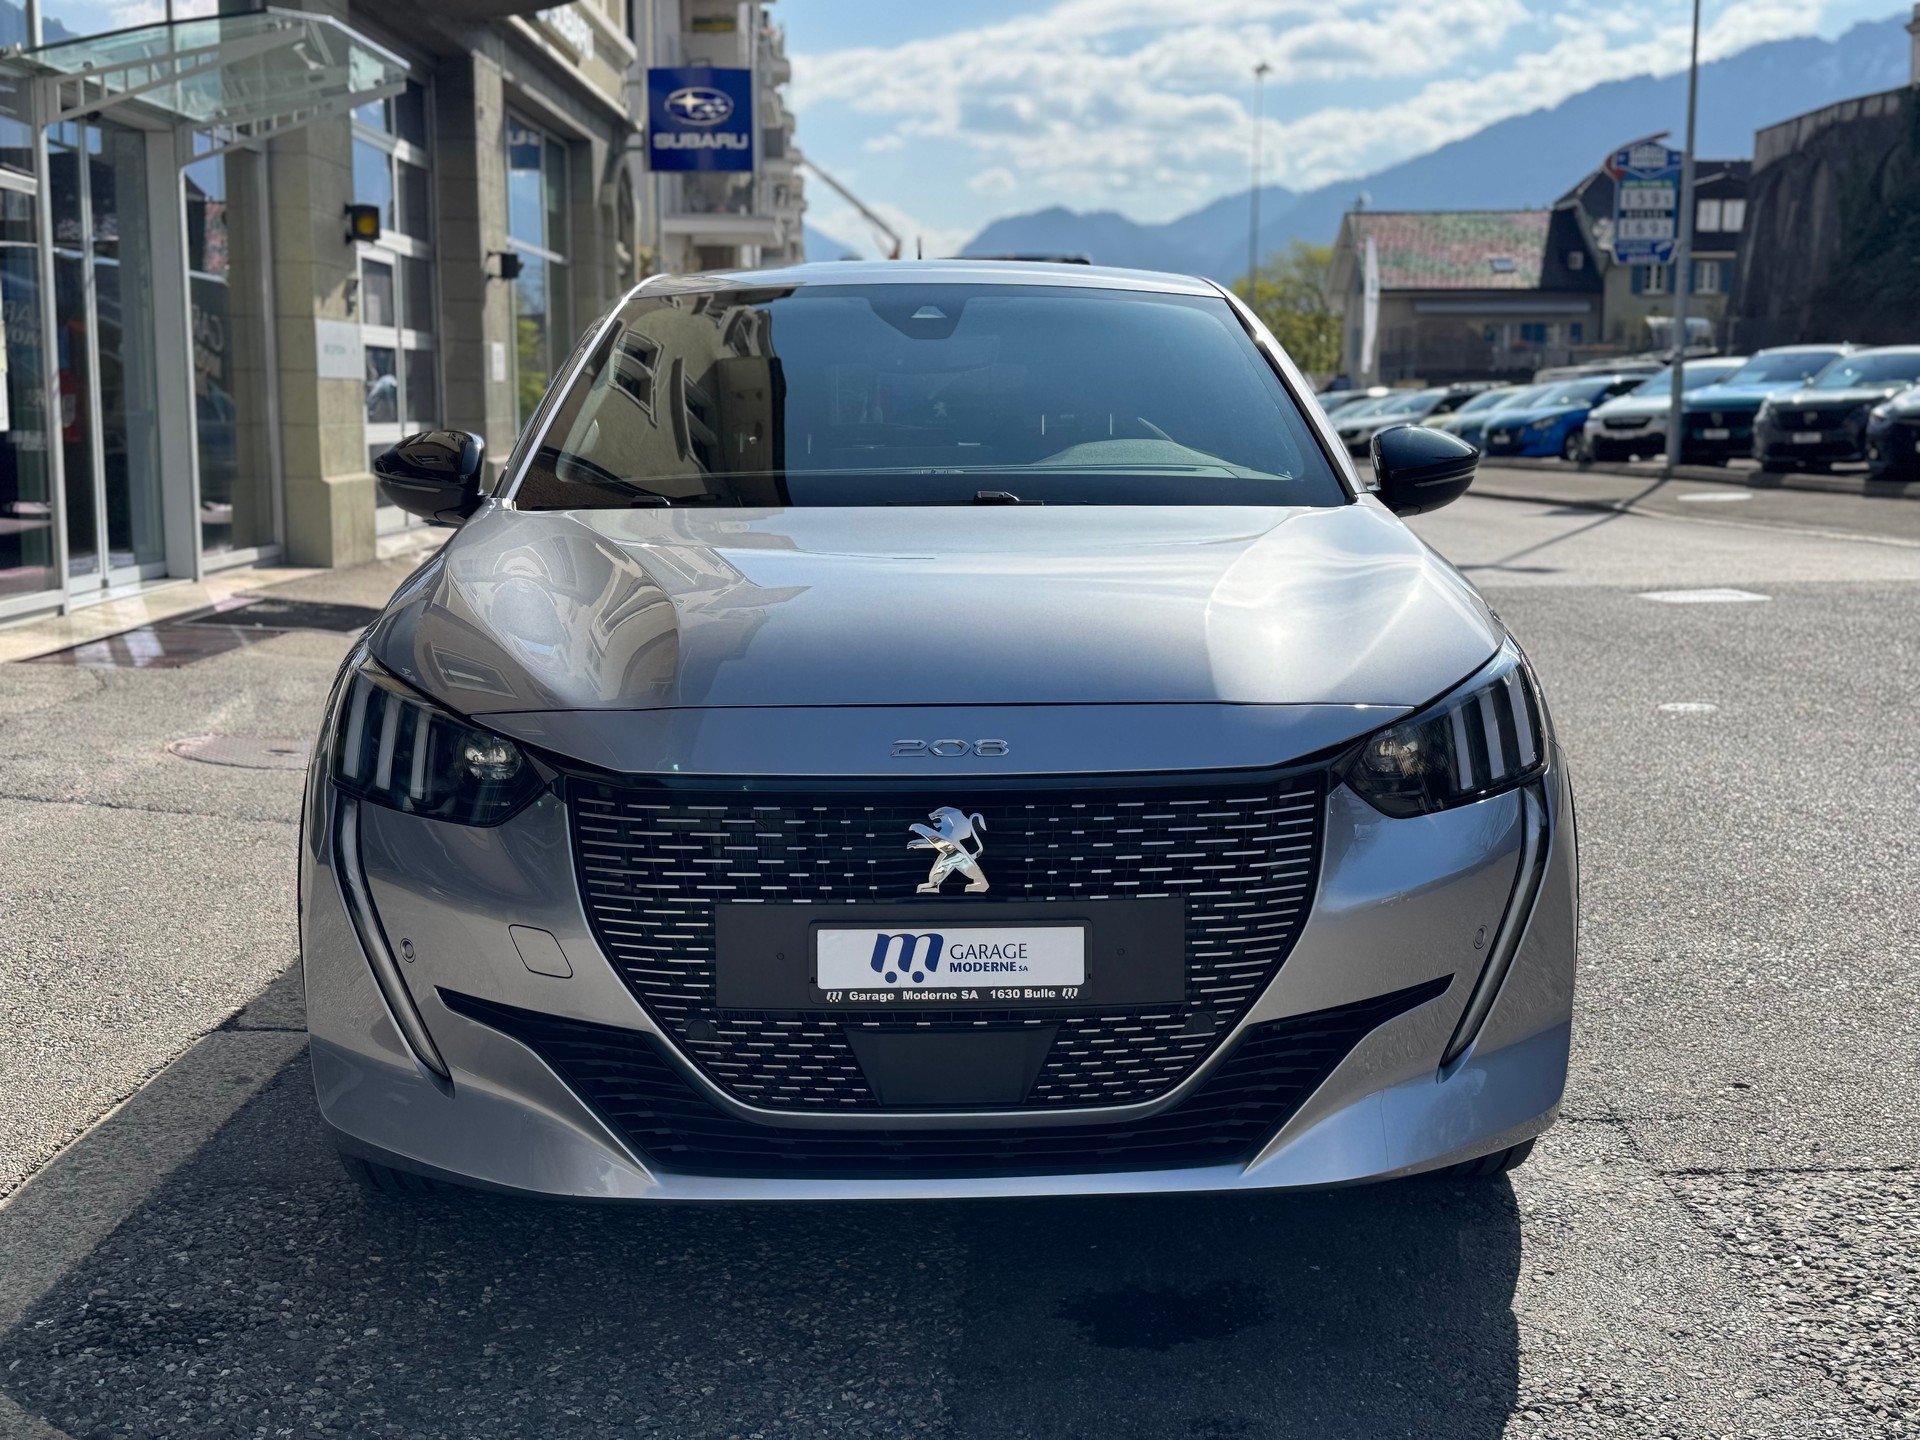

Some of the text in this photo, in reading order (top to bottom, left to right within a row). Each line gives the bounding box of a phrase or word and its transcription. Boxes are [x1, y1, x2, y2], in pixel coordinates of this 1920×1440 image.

[653, 132, 748, 150] SUBARU
[891, 739, 1010, 757] 208
[949, 943, 1028, 960] GARAGE
[949, 961, 1017, 973] MODERNE
[849, 991, 895, 1002] Garage
[902, 990, 958, 1000] Moderne
[961, 990, 978, 1000] SA
[990, 989, 1020, 999] 1630
[1024, 988, 1056, 998] Bulle
